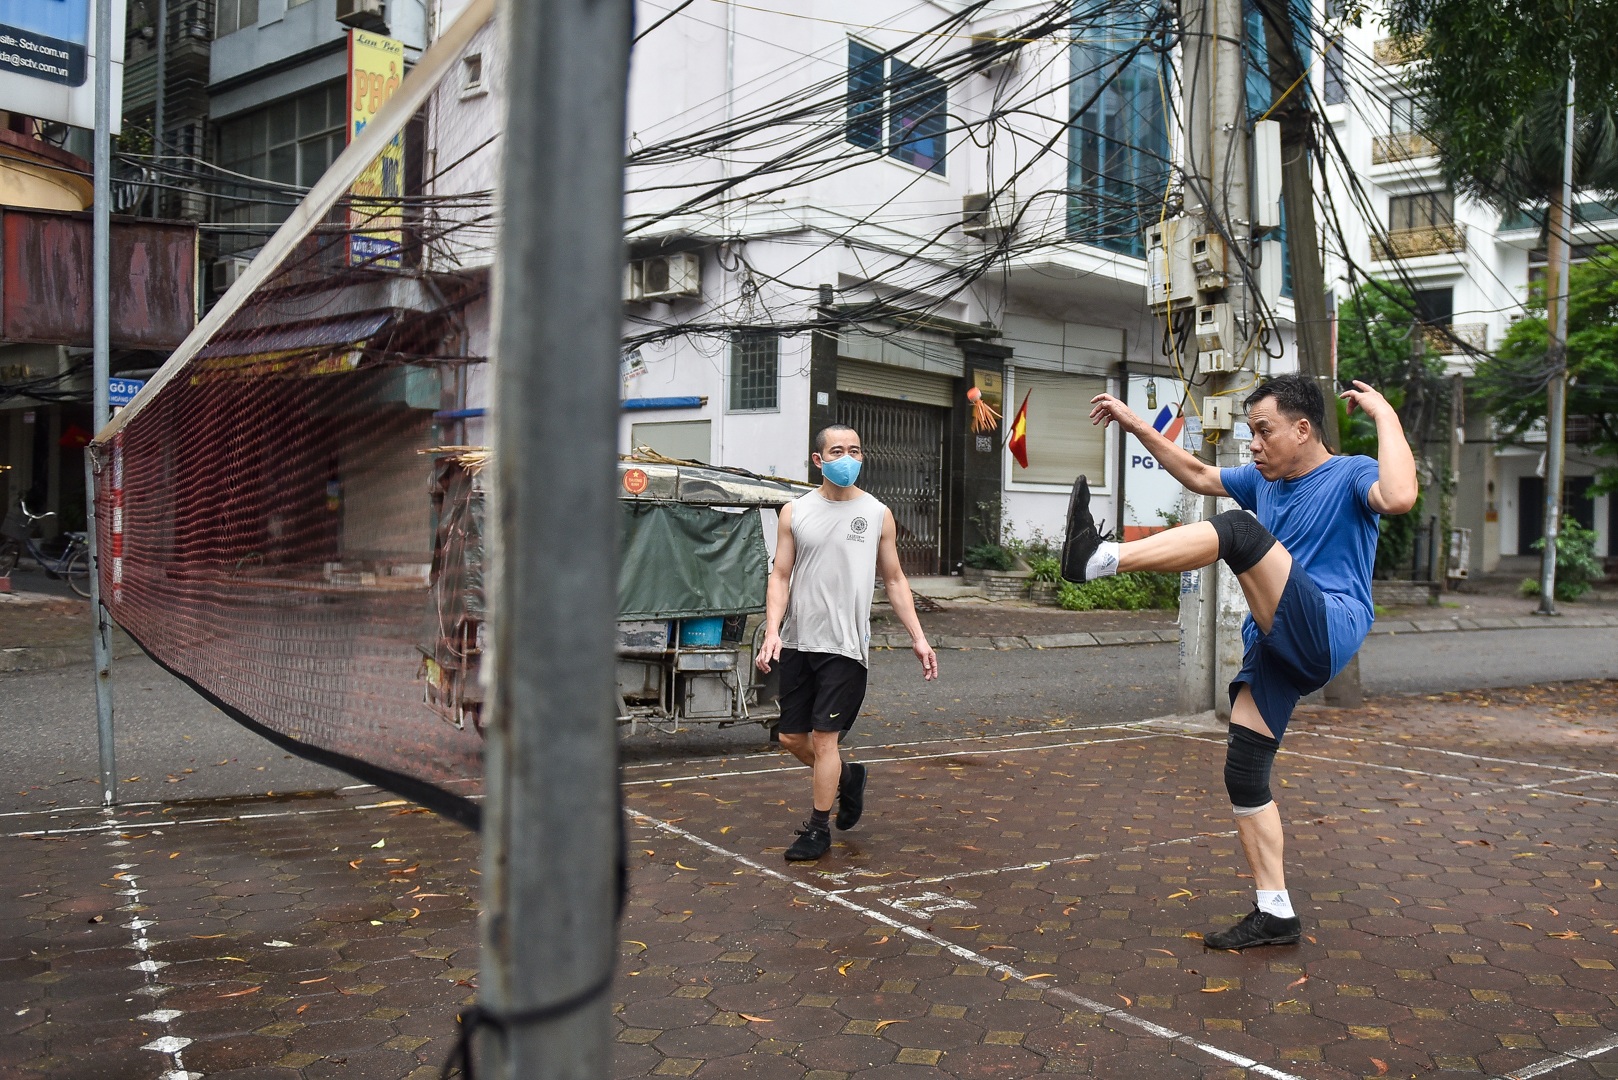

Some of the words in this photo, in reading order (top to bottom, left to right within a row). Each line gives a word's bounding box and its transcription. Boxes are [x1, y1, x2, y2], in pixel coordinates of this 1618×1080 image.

[19, 38, 69, 60] Sctv.com.vn
[109, 381, 126, 393] GÕ
[1132, 455, 1154, 469] PG
